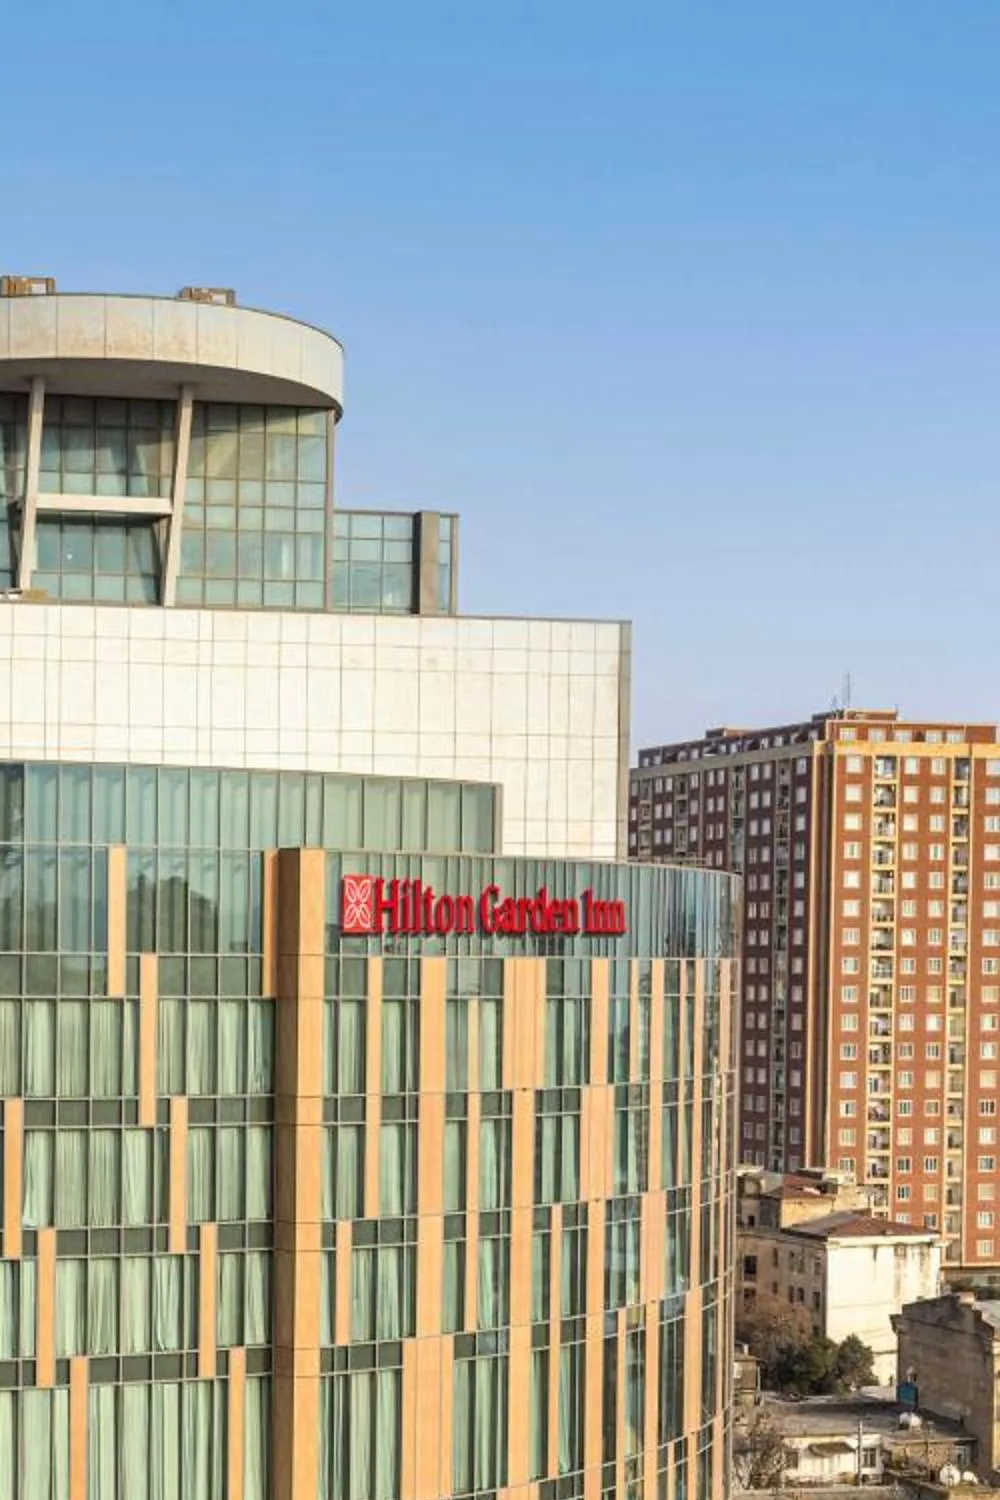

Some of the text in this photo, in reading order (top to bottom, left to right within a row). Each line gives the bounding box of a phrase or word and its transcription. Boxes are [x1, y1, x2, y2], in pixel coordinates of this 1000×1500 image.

[373, 876, 627, 935] Hilton Garden Inn
